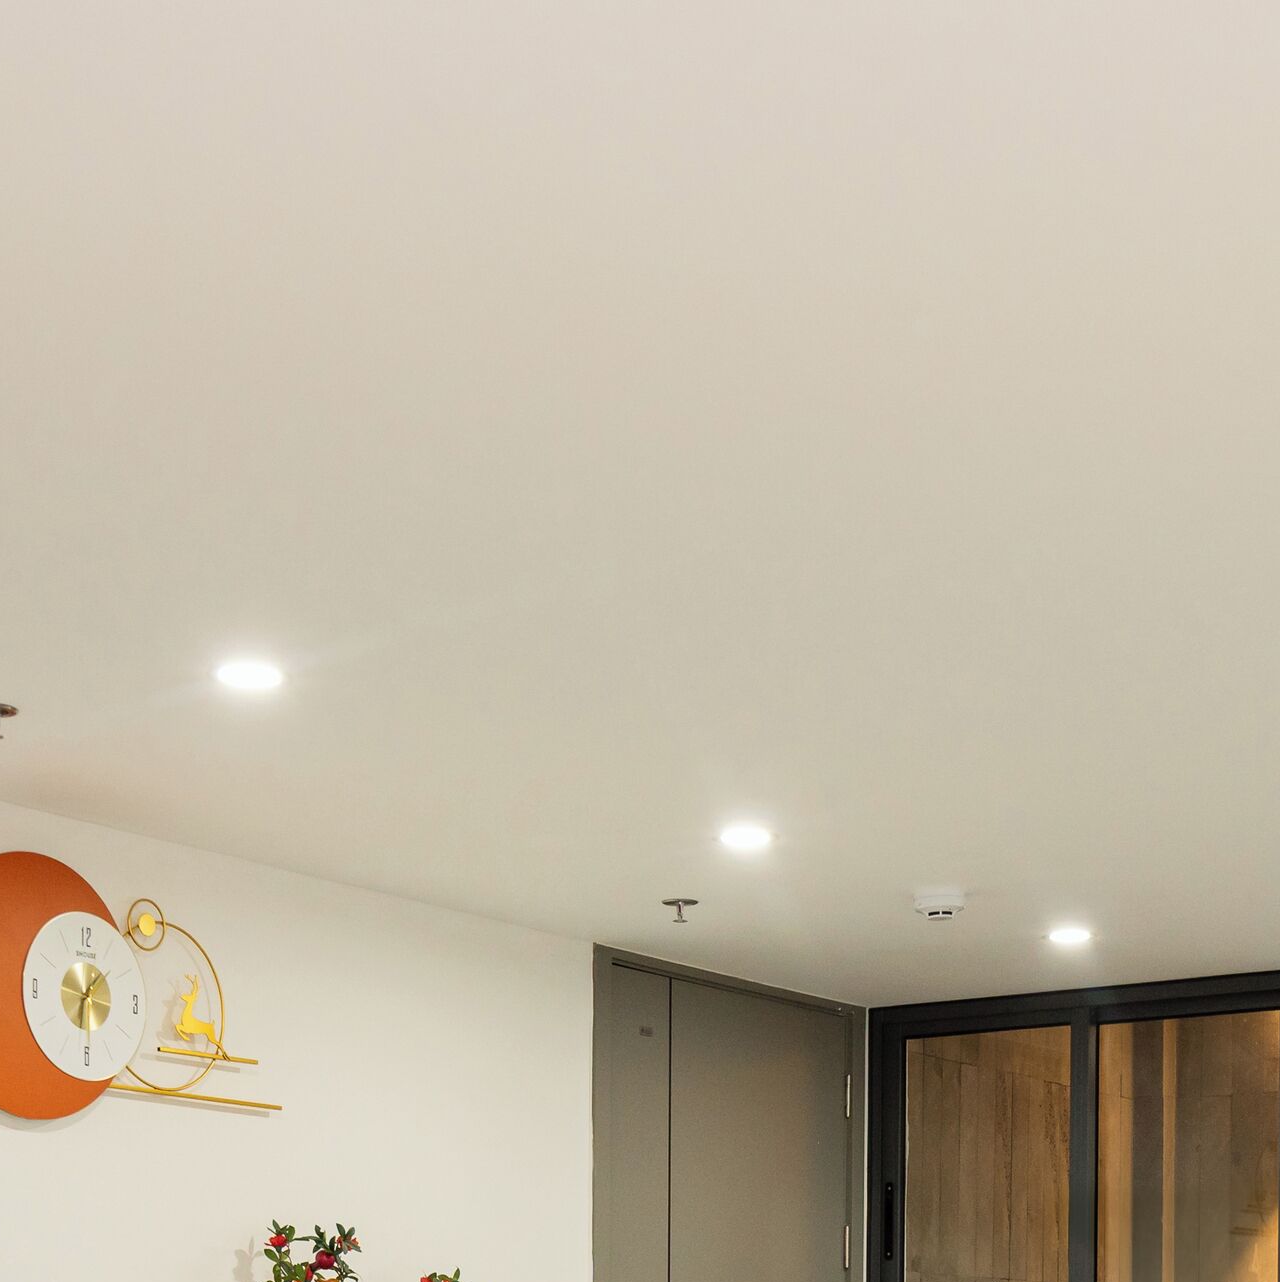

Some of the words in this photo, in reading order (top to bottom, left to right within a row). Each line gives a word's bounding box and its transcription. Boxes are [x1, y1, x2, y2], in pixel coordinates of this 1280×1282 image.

[81, 926, 91, 948] 12
[132, 994, 139, 1015] 3
[84, 1046, 90, 1067] 6
